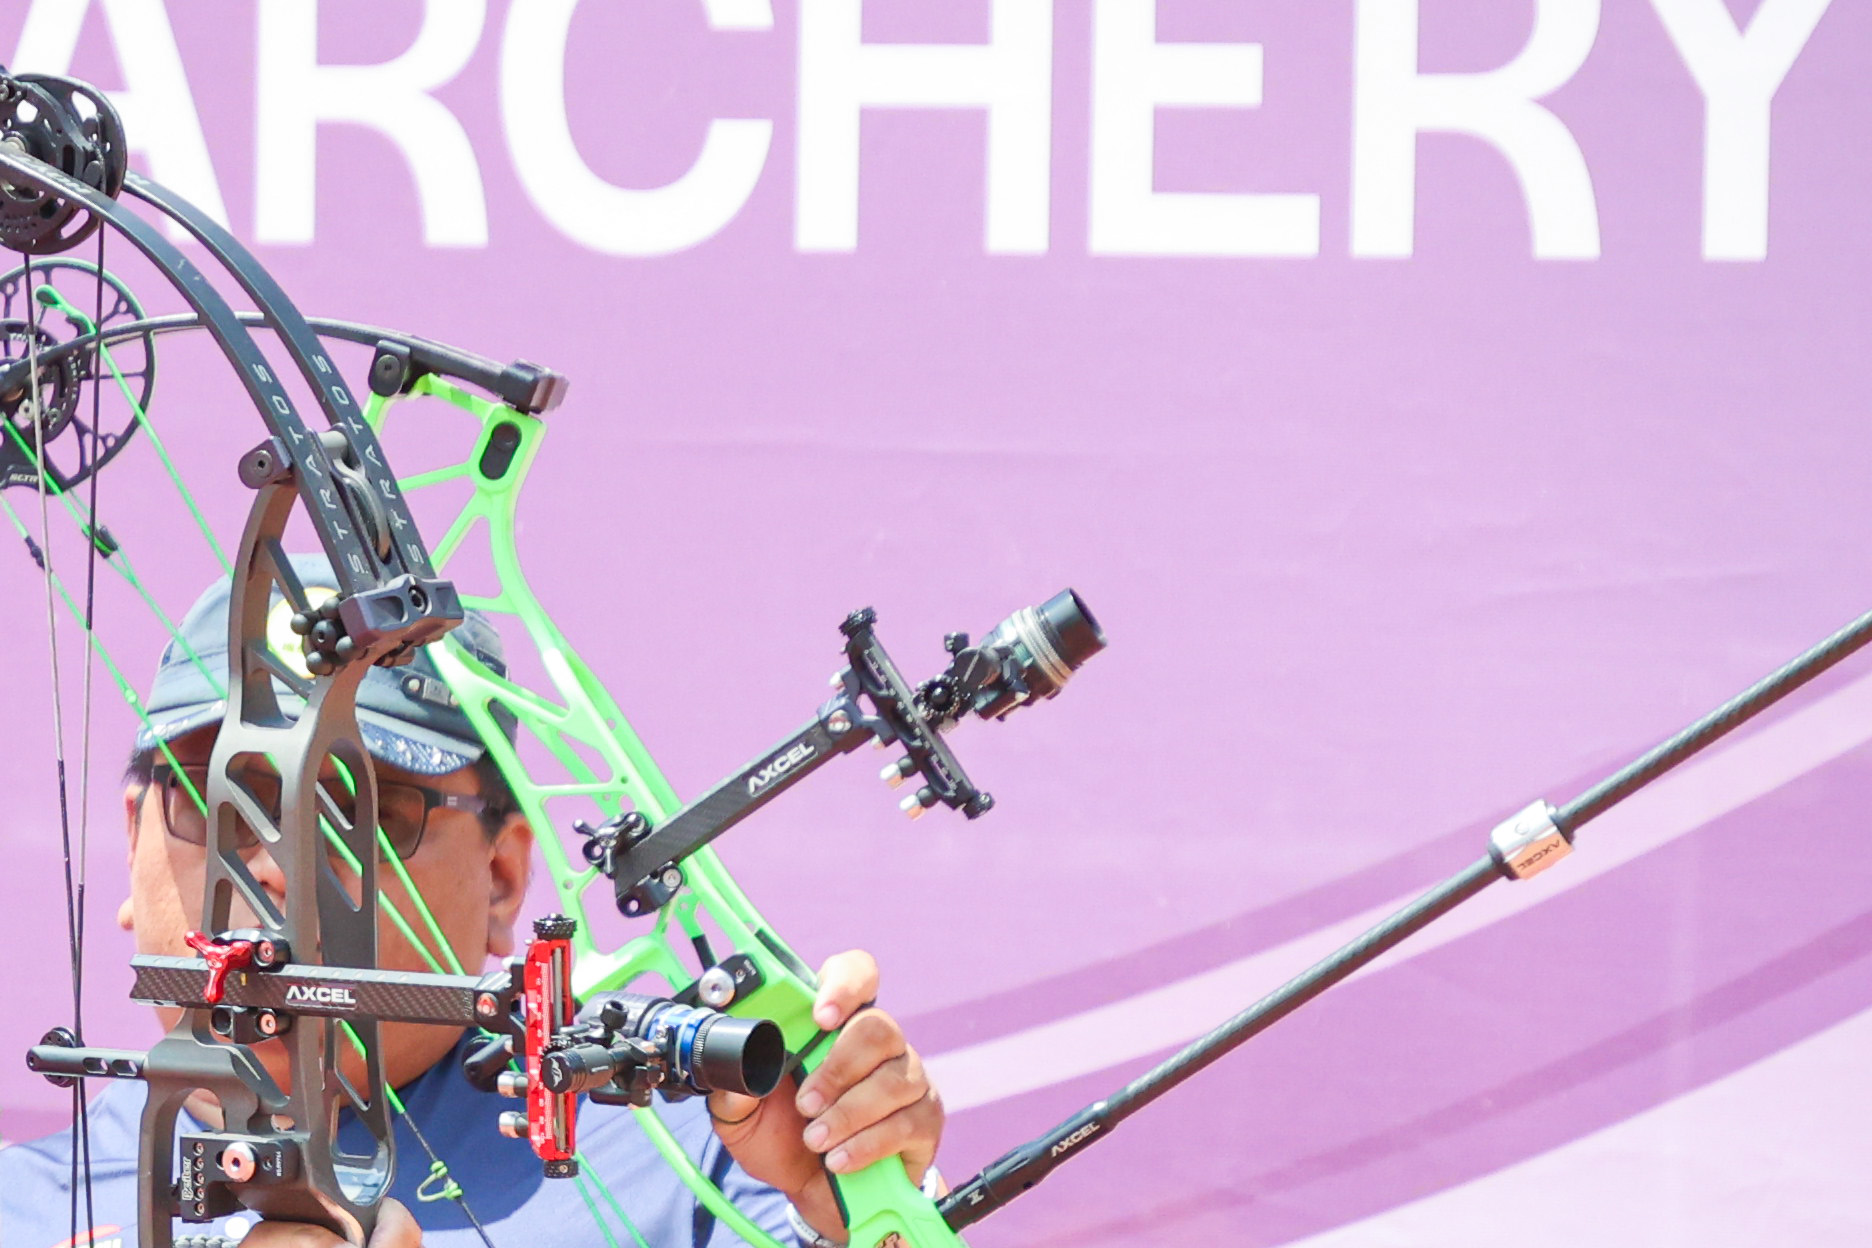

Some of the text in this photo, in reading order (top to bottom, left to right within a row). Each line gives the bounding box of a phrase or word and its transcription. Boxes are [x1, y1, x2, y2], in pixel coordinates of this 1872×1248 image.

[252, 362, 370, 576] STRATOS
[312, 353, 425, 565] STRATOS
[748, 742, 815, 793] AXCEL
[1517, 839, 1560, 870] AXCEL
[285, 984, 357, 1005] AXCEL
[1050, 1120, 1101, 1158] AXCEL
